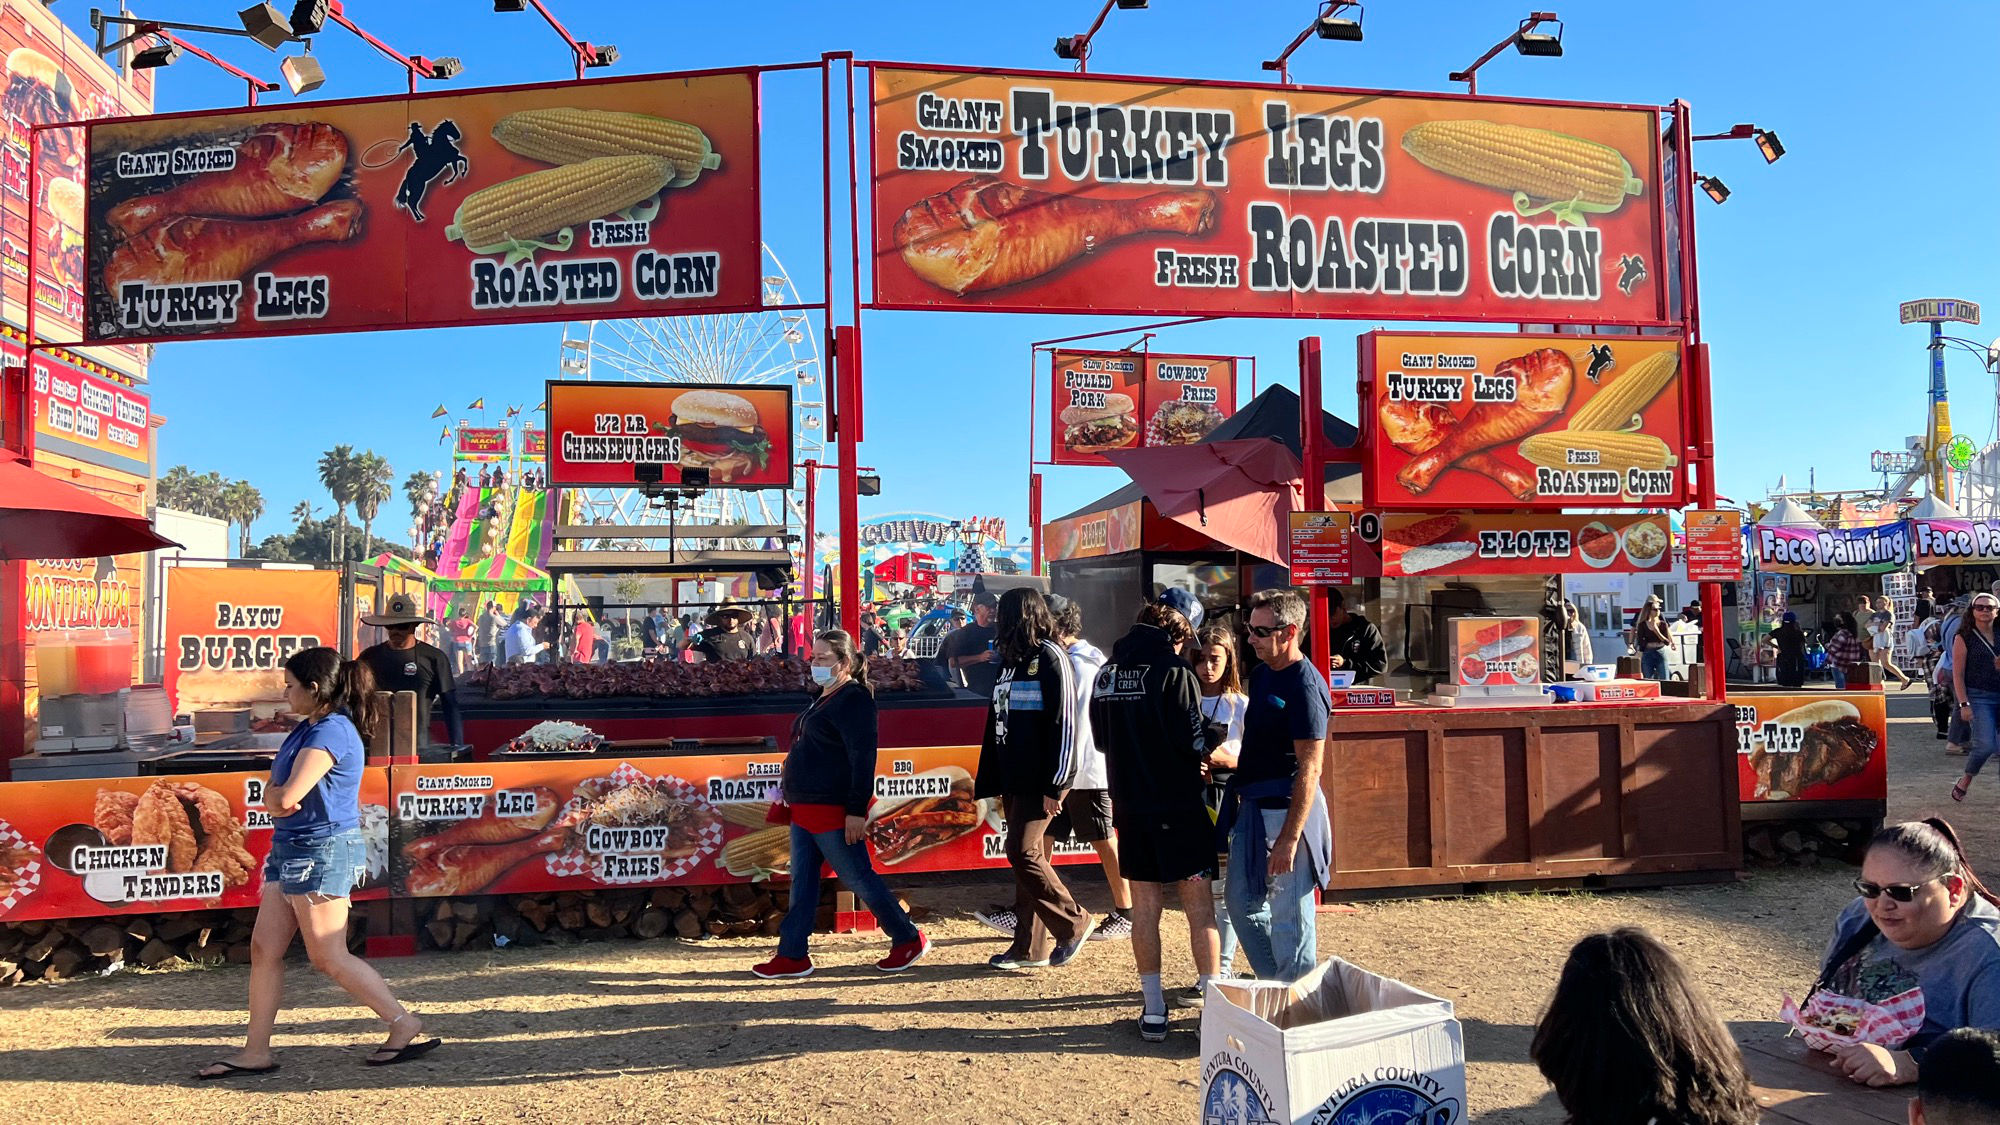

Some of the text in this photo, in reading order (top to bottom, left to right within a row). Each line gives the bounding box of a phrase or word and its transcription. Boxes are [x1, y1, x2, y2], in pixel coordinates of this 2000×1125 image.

[918, 90, 1382, 189] GIANT TURKEY LEGS
[119, 149, 235, 176] GIANT SMOKED
[899, 133, 1002, 171] SMOKED
[591, 221, 648, 245] FRESH
[1156, 204, 1600, 298] FRESH ROASTED CORN
[474, 252, 717, 306] ROASTED CORN
[121, 283, 239, 326] TURKEY
[257, 275, 327, 318] LEGS
[1902, 302, 1977, 321] EVOLUTION
[1082, 359, 1134, 372] SLOW SMOKED
[1158, 363, 1208, 381] COWBOY
[1402, 354, 1476, 368] GIANT SMOKED
[1065, 371, 1112, 389] PULLED
[1388, 374, 1515, 400] TURKEY LEGS
[1071, 390, 1106, 408] PORK
[1182, 385, 1217, 401] FRIES
[596, 415, 620, 432] 1/2
[563, 432, 680, 462] CHEESEBURGERS
[1567, 450, 1599, 463] FRESH
[1538, 468, 1672, 494] ROASTED CORN
[864, 519, 952, 547] CONVOY
[1480, 531, 1571, 556] ELOTE
[1916, 522, 1972, 558] Face
[1759, 528, 1815, 566] Face
[1817, 528, 1907, 567] Painting
[217, 603, 281, 627] BAYOU
[1117, 669, 1142, 679] SALTY
[1486, 661, 1518, 672] ELOTE
[1117, 679, 1139, 690] CREW
[1347, 692, 1376, 703] TURKEY
[1737, 723, 1802, 750] I-TIP
[748, 763, 781, 776] FRESH
[894, 761, 913, 774] BBQ
[417, 776, 492, 789] GIANT SMOKED
[709, 779, 779, 802] ROAST
[875, 776, 951, 797] CHICKEN
[400, 792, 535, 819] TURKEY LEG
[588, 828, 667, 850] COWBOY
[74, 847, 164, 871] CHICKEN
[603, 855, 660, 879] FRIES
[122, 873, 222, 899] TENDERS
[1202, 1051, 1276, 1114] VENTURA COUNTY
[1373, 1066, 1446, 1098] COUNTY
